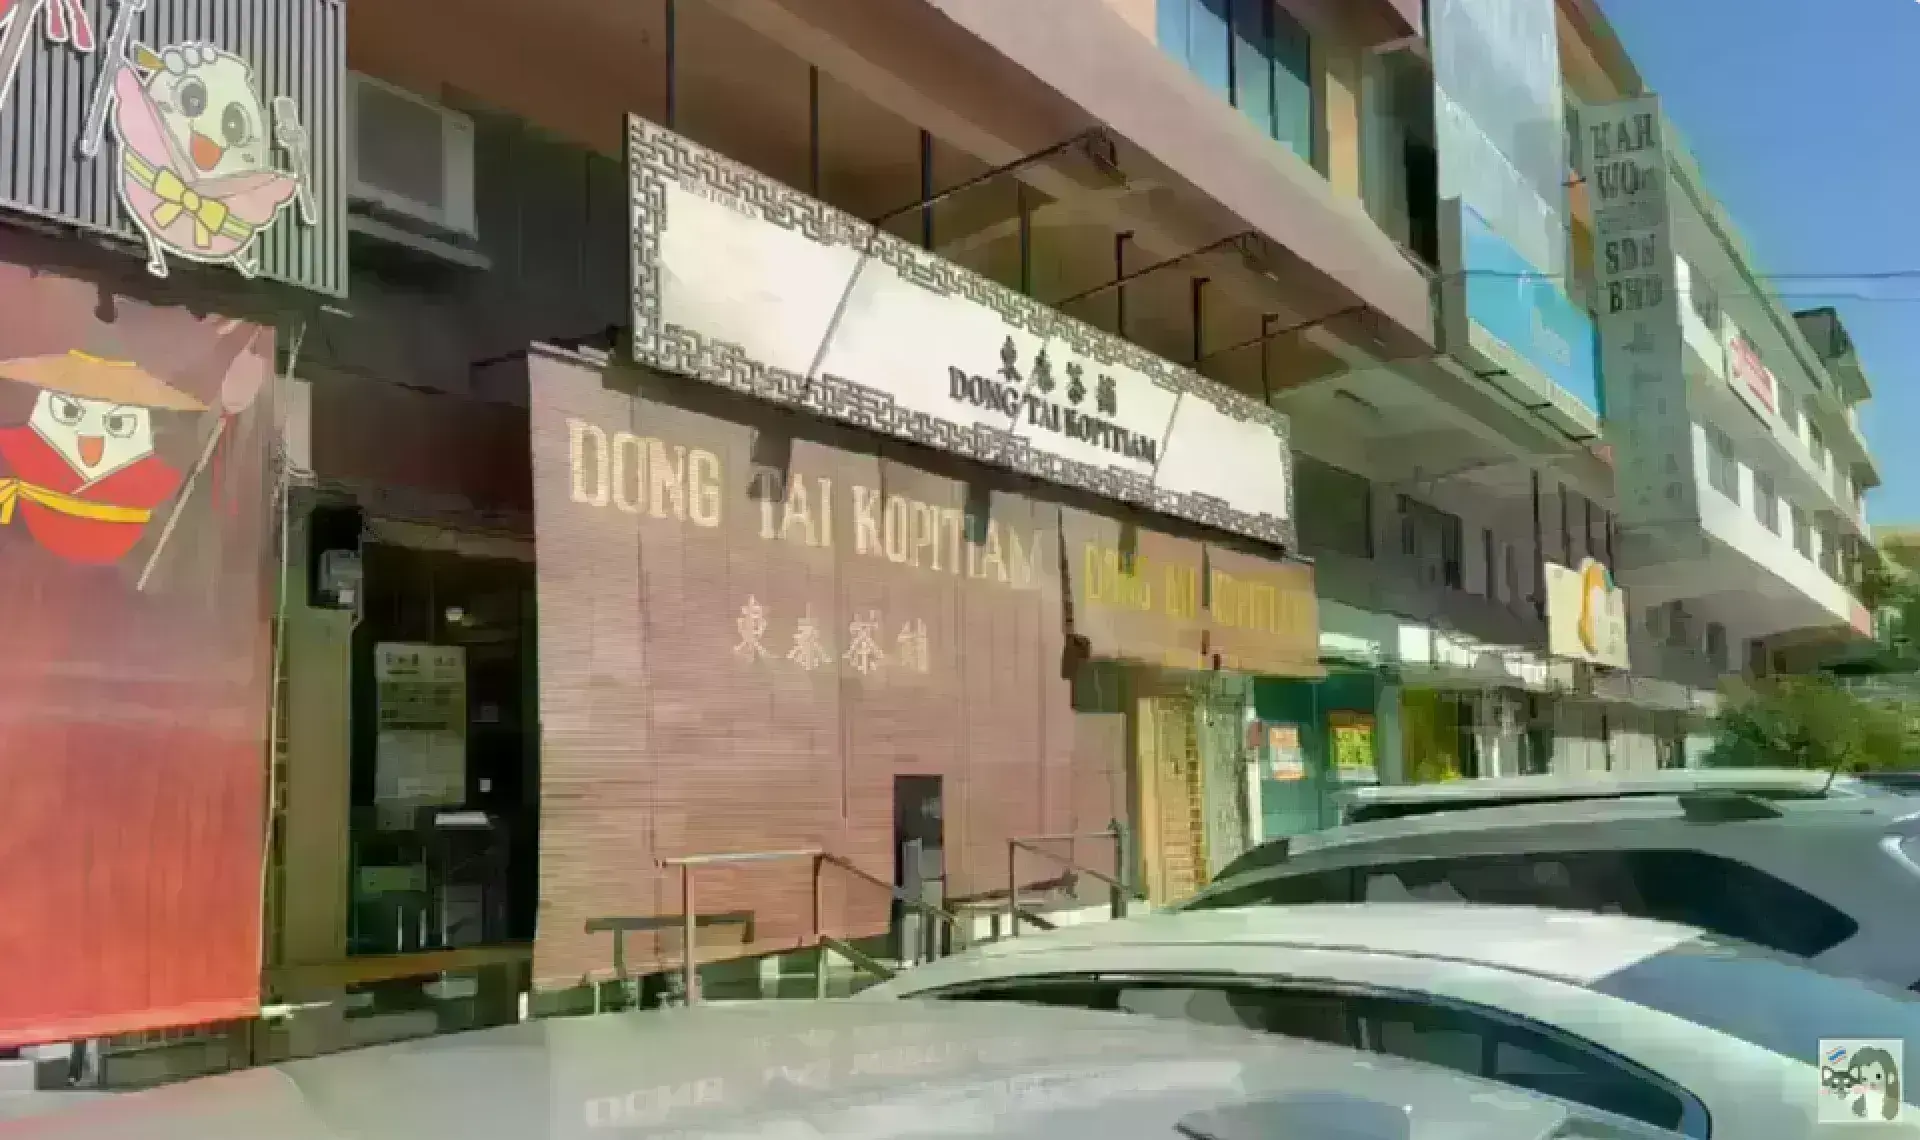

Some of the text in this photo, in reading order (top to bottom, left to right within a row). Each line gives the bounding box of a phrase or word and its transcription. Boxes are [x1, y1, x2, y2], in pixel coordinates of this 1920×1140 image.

[1589, 113, 1656, 159] KAH
[1593, 159, 1661, 199] WO
[1605, 233, 1656, 275] SDN
[948, 365, 1157, 464] DONG TAI KOPITIAM
[566, 417, 1043, 590] DONG TAI KOPITIAM
